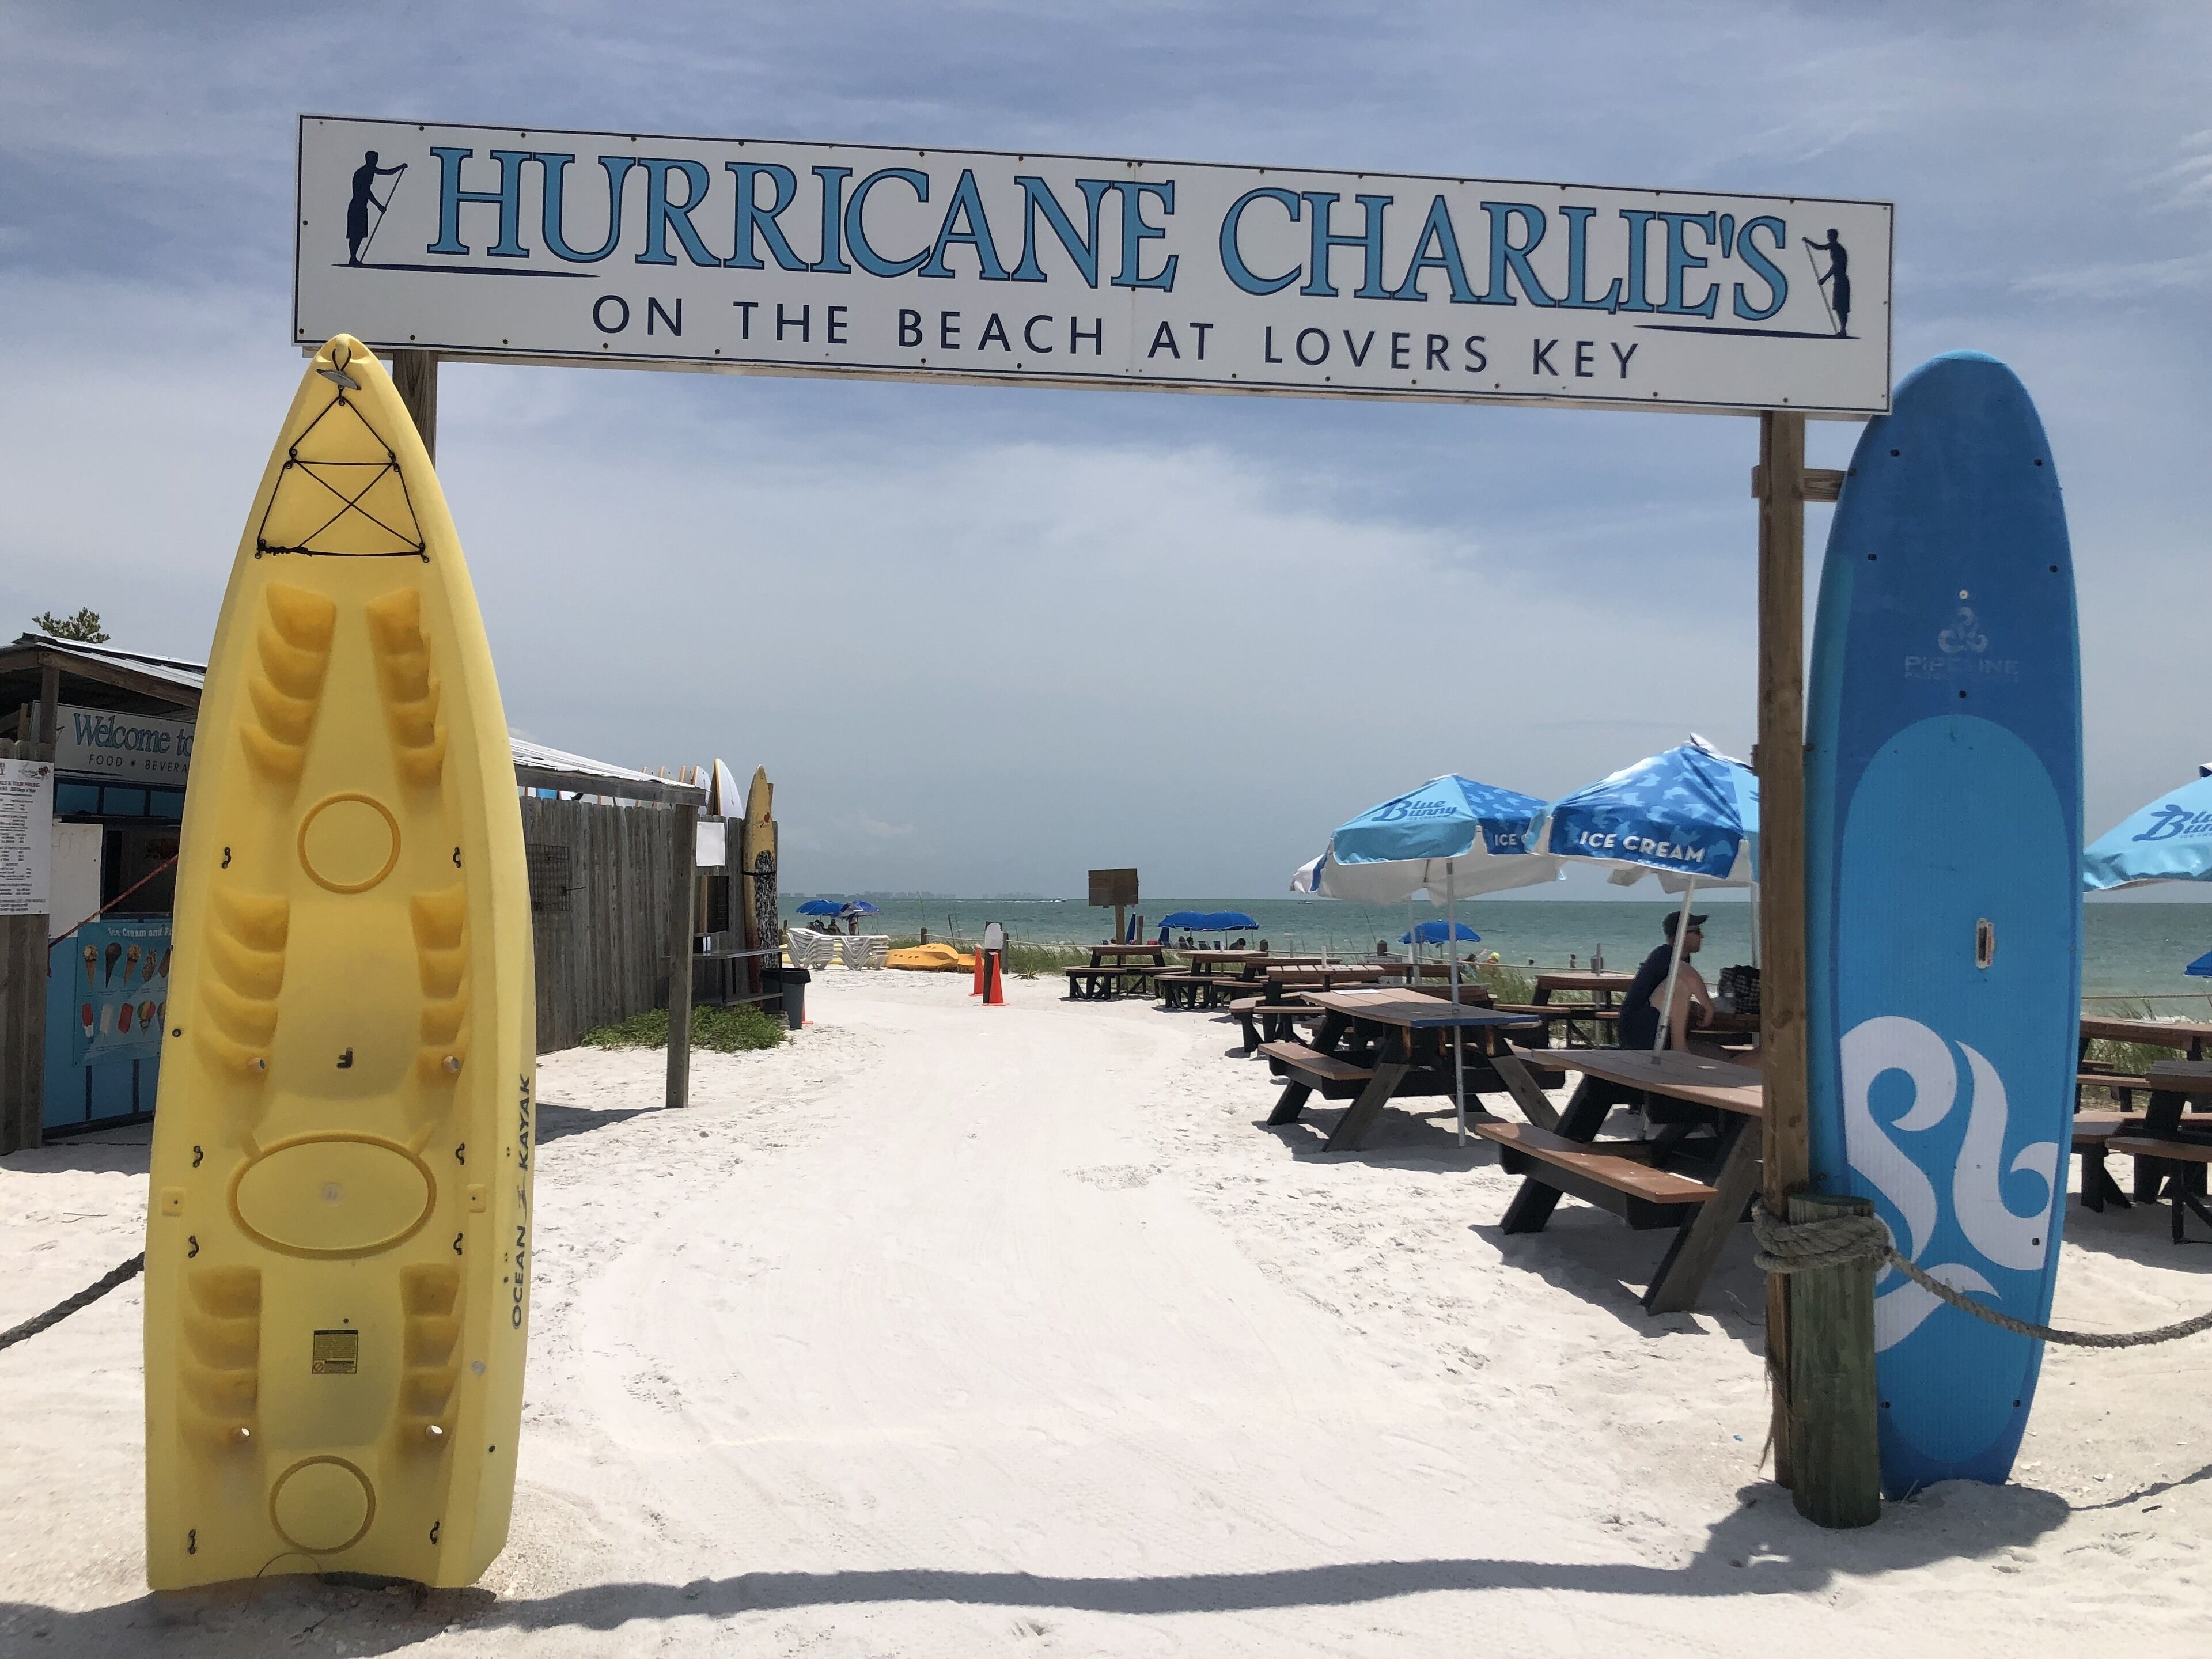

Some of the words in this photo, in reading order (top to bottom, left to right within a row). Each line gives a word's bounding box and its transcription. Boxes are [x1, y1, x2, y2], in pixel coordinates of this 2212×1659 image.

[427, 146, 1179, 293] HURRICANE
[1219, 187, 1789, 321] CHARLIE'S
[592, 294, 682, 336] ON
[733, 301, 848, 344] THE
[898, 309, 1103, 355] BEACH
[1147, 321, 1214, 361] AT
[1264, 325, 1488, 373] LOVERS
[1532, 339, 1639, 379] KEY
[73, 713, 171, 753] Welcome
[89, 753, 123, 767] FOOD
[1371, 798, 1445, 821] Blue
[1371, 798, 1457, 821] Bunny
[1494, 834, 1517, 846] ICE
[1579, 831, 1618, 848] ICE
[1622, 836, 1706, 863] CREAM
[122, 927, 146, 937] Cream
[149, 929, 162, 937] and
[518, 1073, 531, 1171] KAYAK
[512, 1225, 527, 1330] OCEAN
